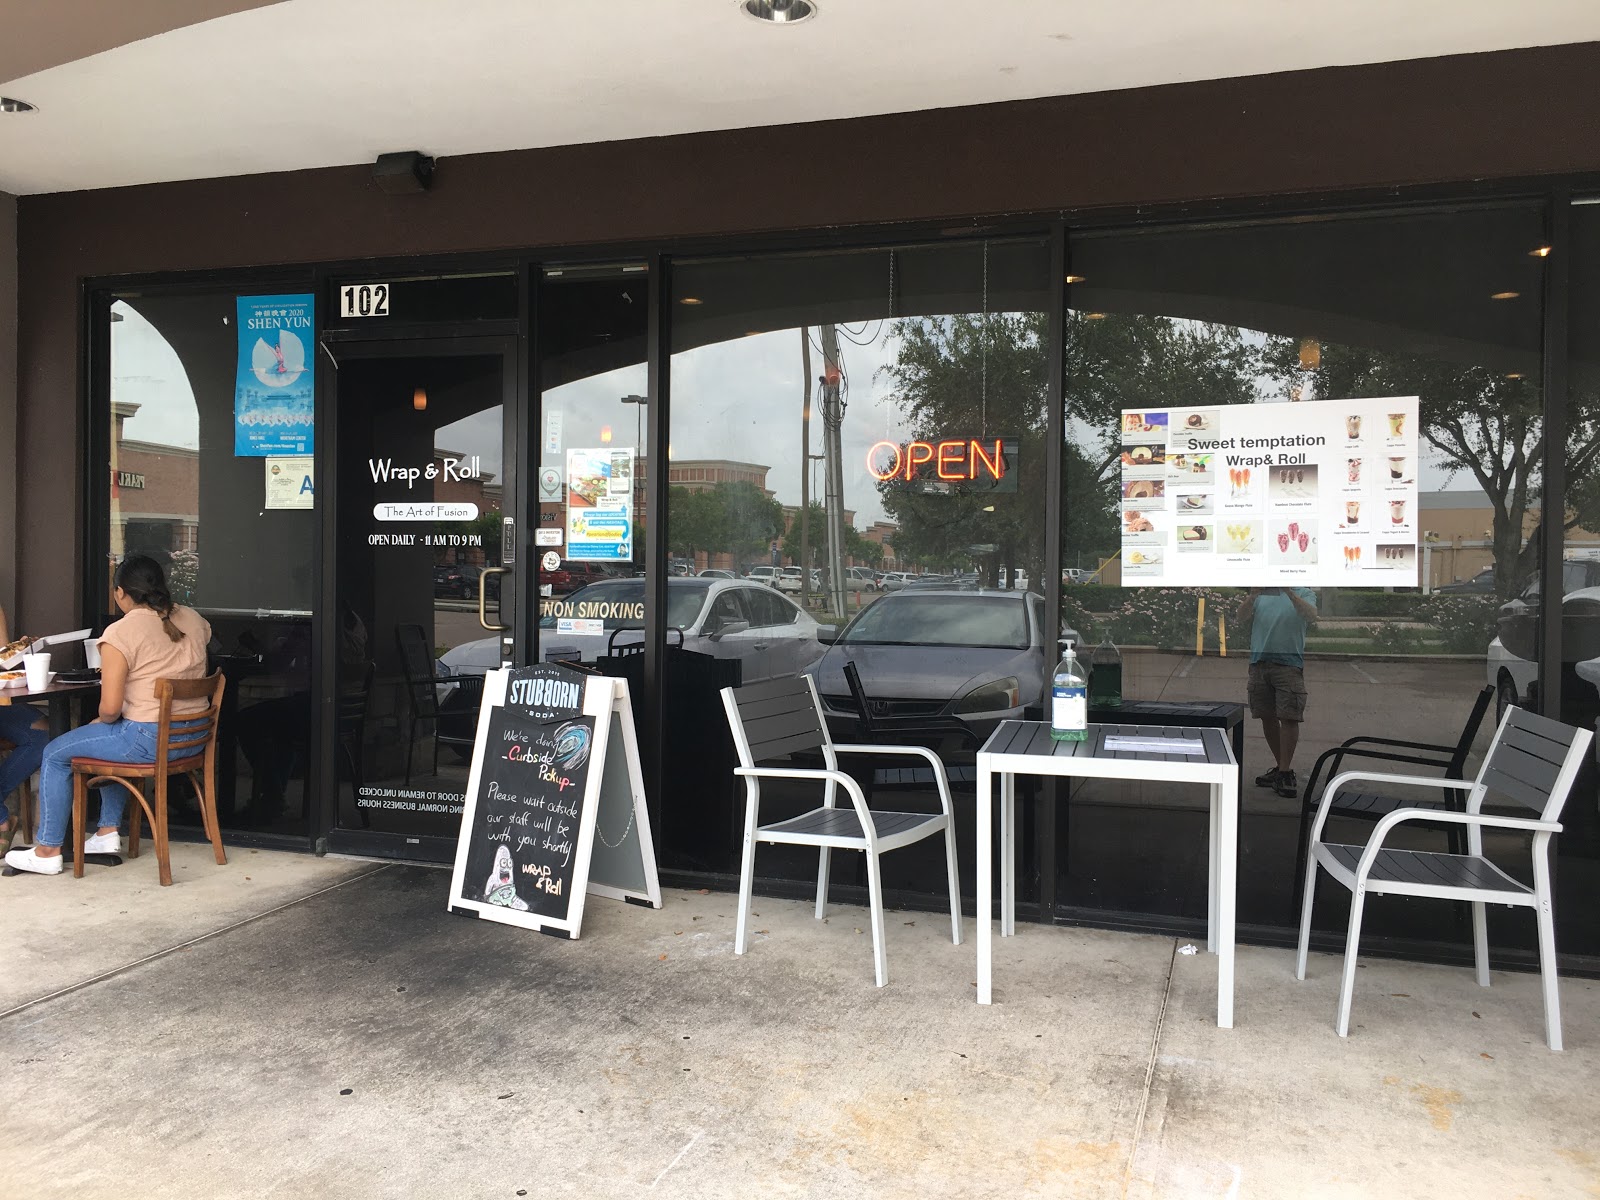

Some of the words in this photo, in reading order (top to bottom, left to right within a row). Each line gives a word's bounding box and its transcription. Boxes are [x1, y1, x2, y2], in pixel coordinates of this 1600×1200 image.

[344, 285, 387, 315] 102
[288, 308, 304, 316] 2020
[247, 317, 281, 329] SHEN
[284, 316, 311, 328] YUN
[1187, 437, 1235, 450] Sweet
[1240, 434, 1326, 451] temptation
[866, 439, 1002, 481] OPEN
[1226, 454, 1273, 467] Wrap&
[1278, 453, 1306, 464] Roll
[368, 458, 420, 489] Wrap
[424, 462, 440, 480] &
[443, 455, 481, 483] Roll
[299, 474, 314, 494] A
[384, 505, 403, 518] The
[405, 505, 423, 518] Art
[424, 505, 435, 518] of
[437, 505, 468, 518] Fusion
[368, 533, 390, 546] OPEN
[391, 534, 416, 546] DAILY
[424, 534, 431, 546] 11
[432, 534, 447, 546] AM
[448, 534, 460, 546] TO
[461, 534, 468, 546] 9
[469, 534, 482, 546] PM
[543, 601, 575, 617] NON
[578, 601, 645, 619] SMOKING
[510, 678, 580, 709] STUBBORN
[528, 710, 555, 719] SODA
[503, 729, 529, 743] We're
[535, 732, 559, 759] doing
[487, 781, 517, 803] Please
[523, 795, 545, 808] wait
[547, 800, 578, 818] outside
[486, 814, 504, 823] our
[508, 811, 531, 826] staff
[533, 816, 552, 832] will
[557, 819, 570, 837] be
[487, 825, 511, 842] with
[516, 835, 537, 852] you
[542, 835, 573, 867] shortly
[522, 863, 552, 879] WRAP
[545, 877, 562, 896] Roll
